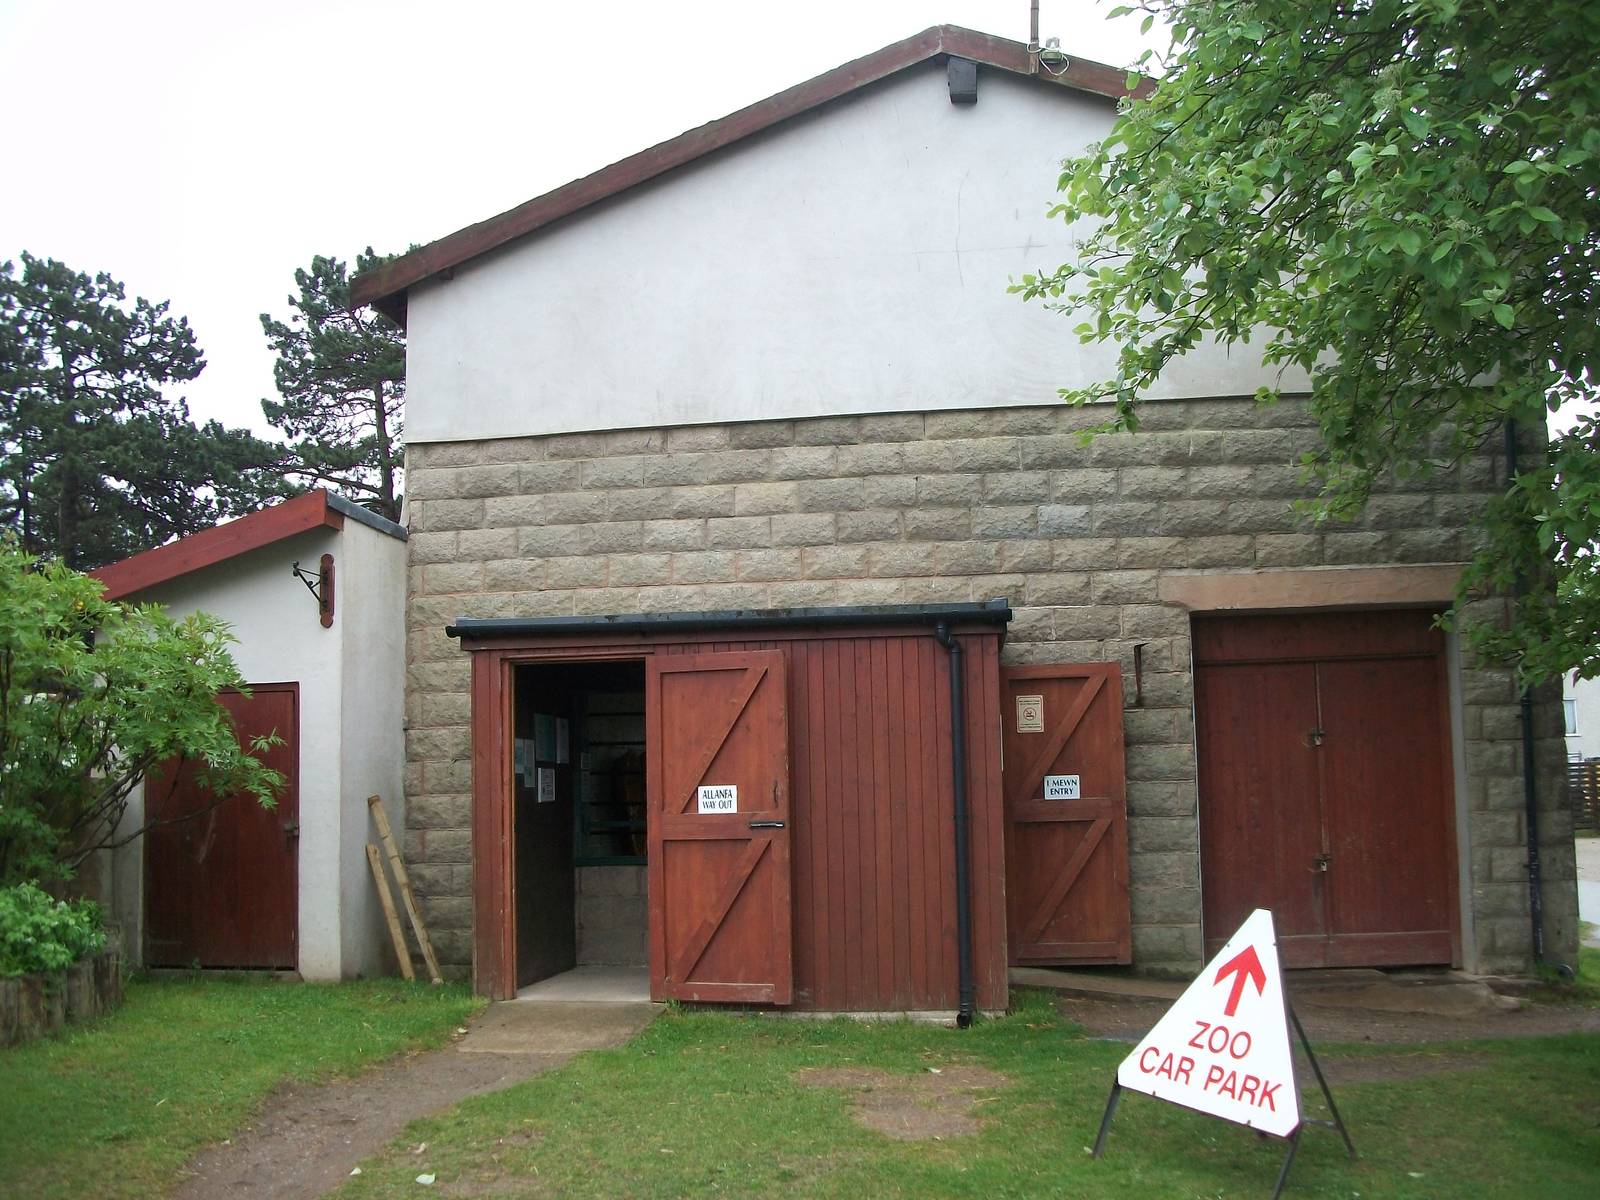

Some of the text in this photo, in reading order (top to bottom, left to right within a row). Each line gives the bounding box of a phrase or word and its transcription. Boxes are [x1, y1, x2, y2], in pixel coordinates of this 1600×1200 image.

[702, 789, 733, 799] ALLANFA
[702, 799, 732, 809] WAY OUT
[1188, 1020, 1252, 1060] ZOO
[1139, 1046, 1282, 1112] CAR PARK
